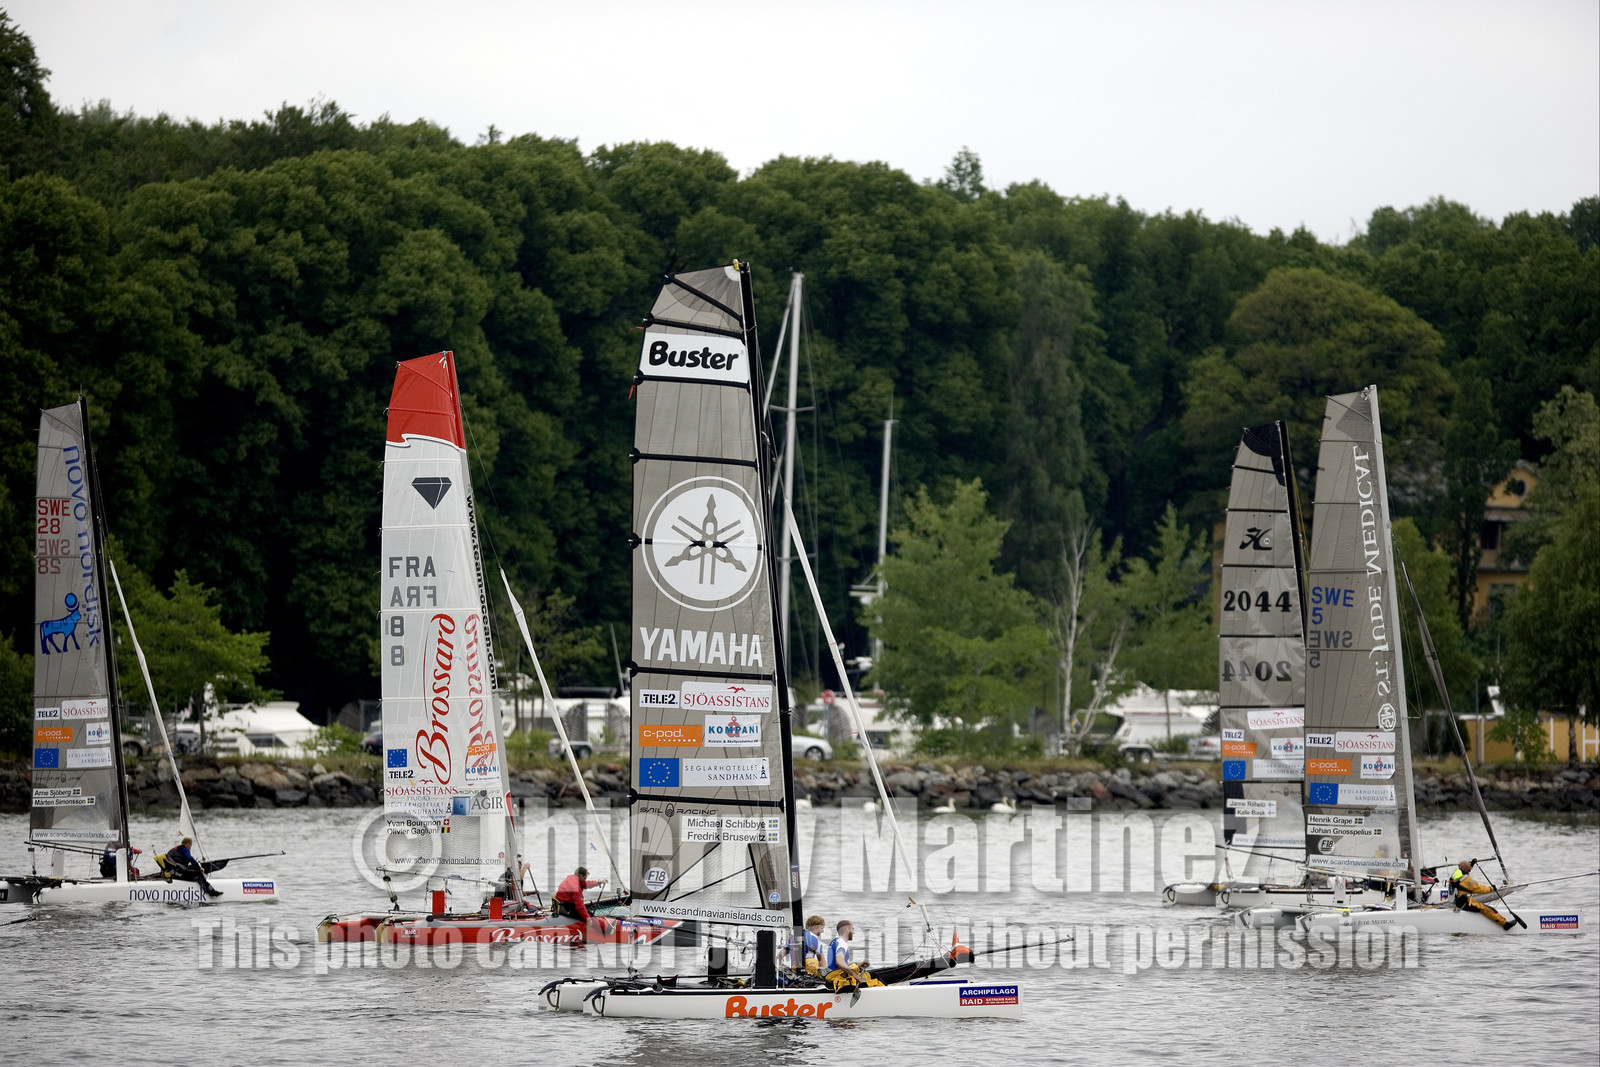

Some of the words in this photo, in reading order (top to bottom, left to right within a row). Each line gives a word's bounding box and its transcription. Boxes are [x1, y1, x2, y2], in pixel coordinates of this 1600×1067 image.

[649, 341, 739, 370] Buster
[38, 499, 70, 516] SWE
[38, 518, 61, 534] 28
[63, 445, 88, 522] novo
[78, 531, 101, 647] nordisk
[389, 556, 436, 578] FRA
[466, 494, 498, 690] www.team-ocean.com
[1311, 586, 1355, 607] SWE
[1224, 590, 1292, 612] 2044
[1311, 607, 1323, 625] 5
[639, 627, 763, 667] YAMAHA
[683, 693, 770, 708] SJÖASSISTANS
[708, 725, 759, 734] KOMPANI
[1337, 740, 1394, 750] SJÖASSISTANS
[389, 770, 414, 779] TELE2
[385, 785, 458, 798] SJÖASSISTANS
[471, 797, 504, 810] AGIR
[640, 806, 663, 814] SAIL
[687, 818, 723, 827] Michael
[725, 819, 766, 830] Schibbye
[1333, 817, 1353, 825] Grape
[687, 831, 720, 841] Fredrik
[722, 832, 766, 842] Brusewitz
[1321, 839, 1334, 848] F18
[1312, 858, 1406, 868] www.scandinavianislands.com
[648, 870, 666, 882] F18
[129, 888, 160, 901] novo
[163, 886, 207, 901] nordisk
[643, 905, 785, 923] www.scandinavianislands.com
[962, 988, 1016, 996] ARCHIPELAGO
